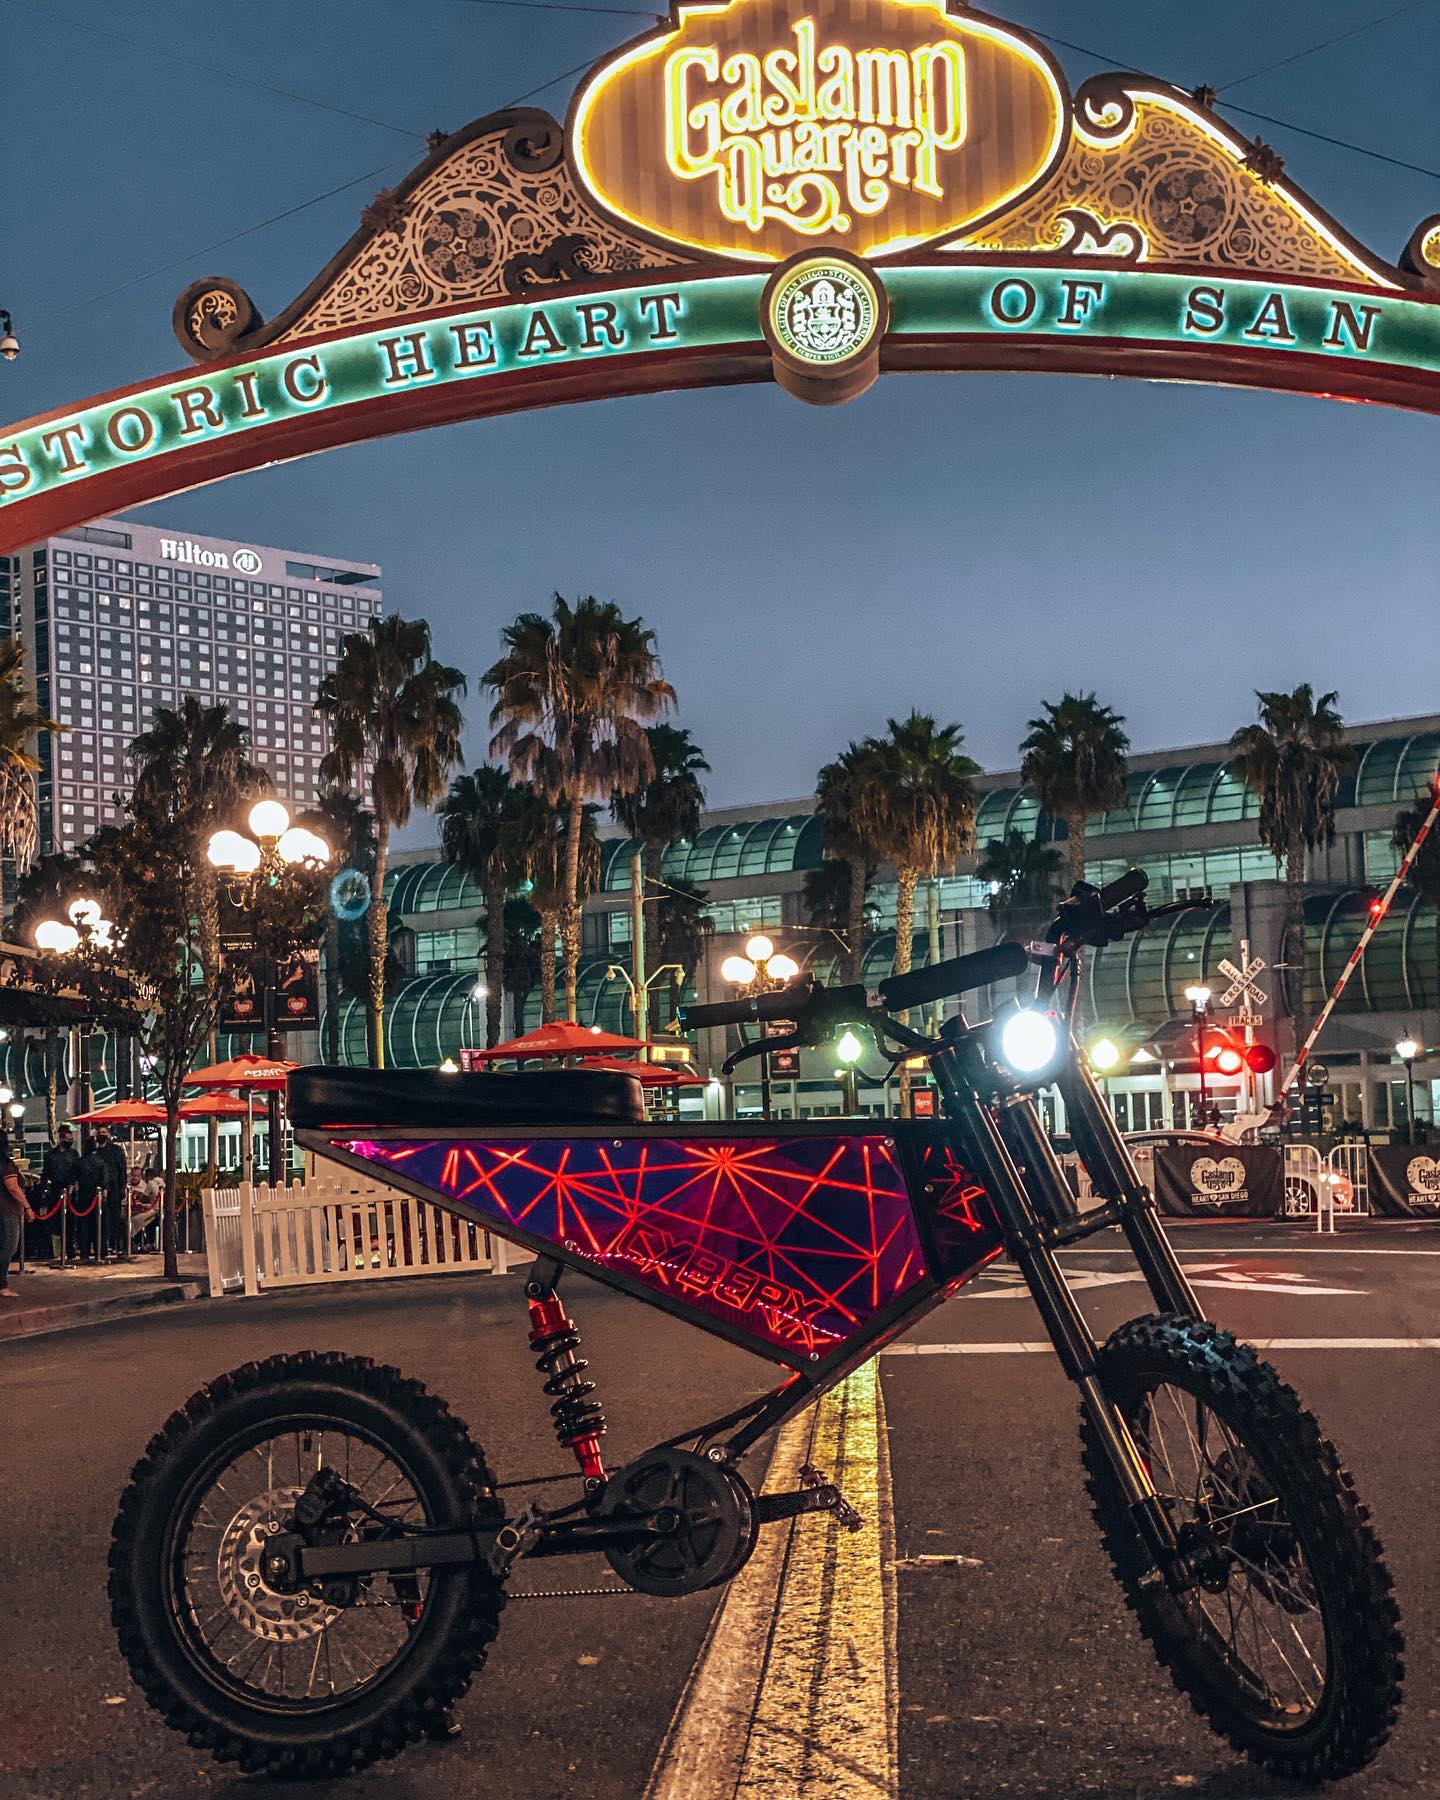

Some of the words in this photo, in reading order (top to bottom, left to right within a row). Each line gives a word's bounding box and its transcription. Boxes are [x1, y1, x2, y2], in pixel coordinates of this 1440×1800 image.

[664, 17, 967, 199] Gaslamp
[718, 121, 923, 234] Quarter
[787, 282, 799, 298] SAN
[799, 270, 824, 282] DIEGO
[829, 270, 852, 284] STATE
[0, 356, 327, 494] STORIC
[378, 294, 682, 384] HEART
[990, 278, 1103, 326] OF
[1184, 286, 1382, 352] SAN
[160, 538, 229, 569] Hilton
[1221, 962, 1240, 981] RAIL
[1245, 983, 1266, 1002] ROAD
[1223, 960, 1263, 1004] CROSSING
[1231, 1016, 1262, 1025] TRACKS
[1242, 1008, 1248, 1017] 3
[1219, 1193, 1230, 1201] SAN
[1231, 1191, 1249, 1200] DIEGO
